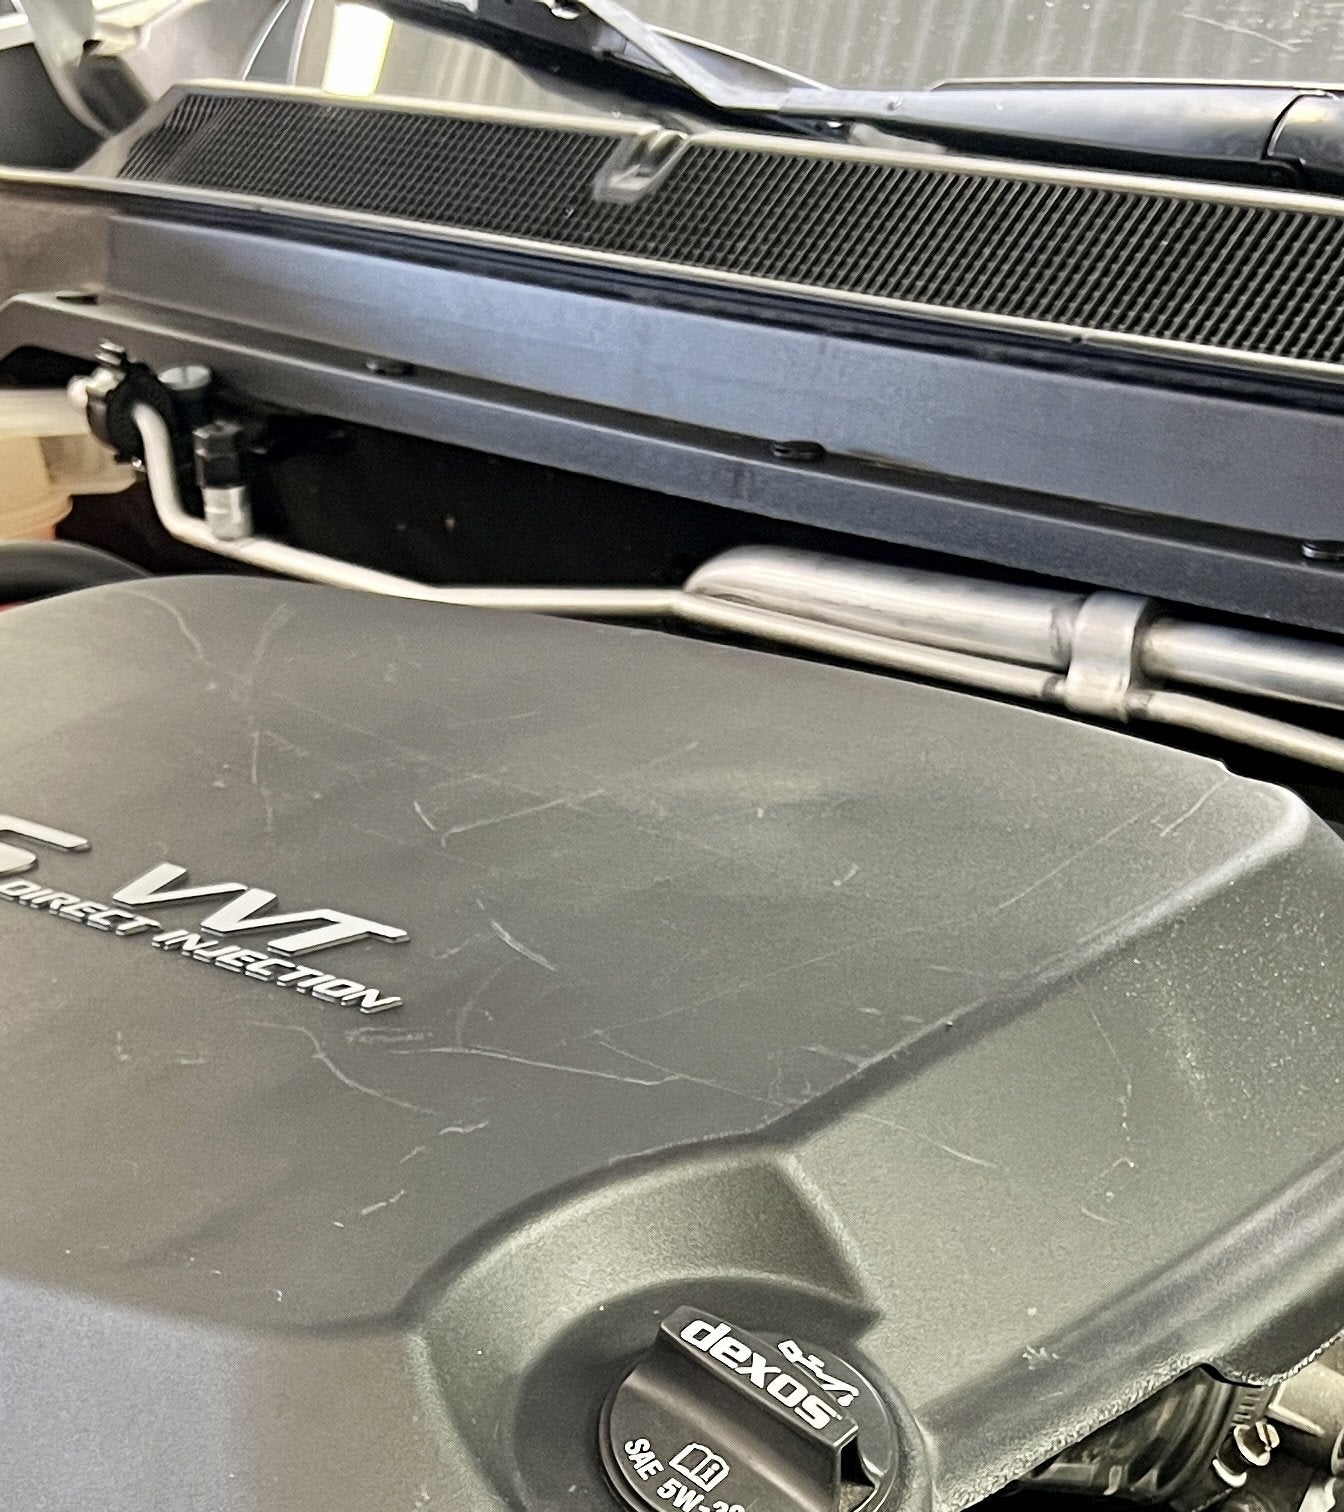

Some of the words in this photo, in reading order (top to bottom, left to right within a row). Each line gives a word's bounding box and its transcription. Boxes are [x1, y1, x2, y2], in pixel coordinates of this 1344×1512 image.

[112, 861, 410, 958] VVT
[150, 927, 404, 1015] INJECTION
[679, 1319, 839, 1430] dexos
[624, 1438, 666, 1482] SAE
